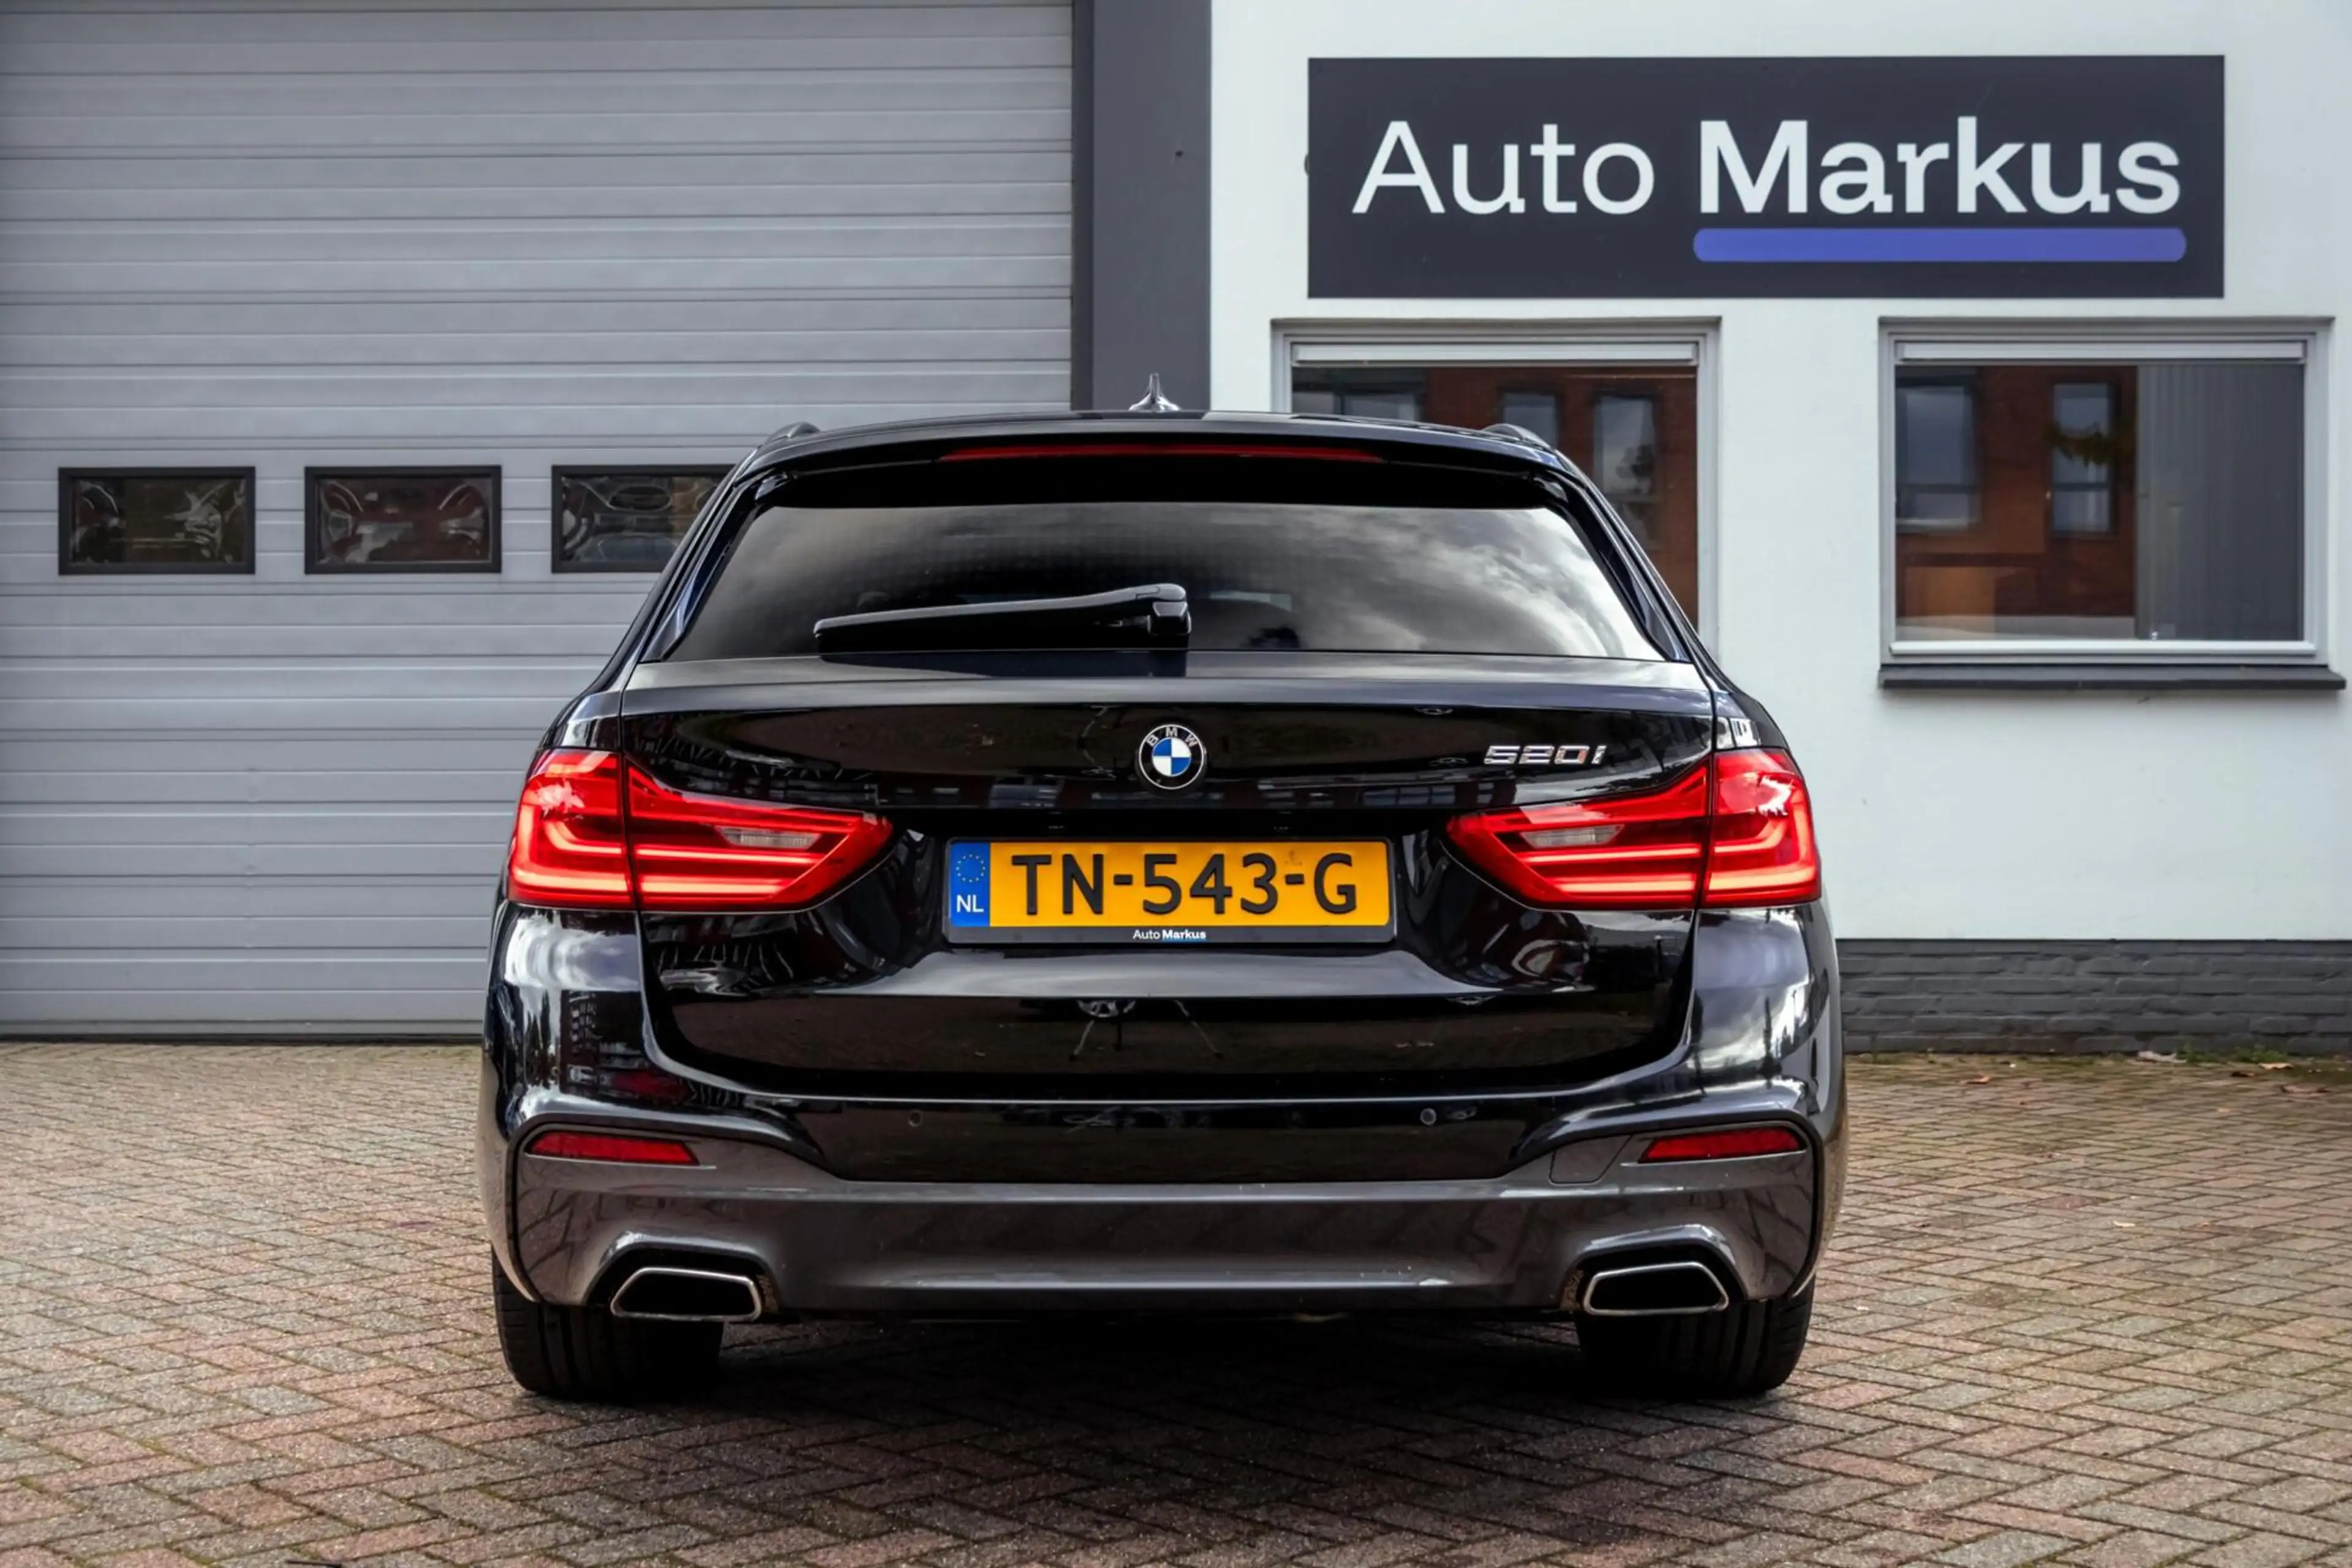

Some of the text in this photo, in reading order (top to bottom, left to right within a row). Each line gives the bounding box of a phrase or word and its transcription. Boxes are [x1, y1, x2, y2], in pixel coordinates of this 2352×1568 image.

[1352, 116, 2180, 215] Auto Markus
[1146, 727, 1198, 747] BMW
[1484, 745, 1607, 765] 520i
[1012, 853, 1357, 915] TN-543-G
[957, 894, 984, 913] NL
[1133, 929, 1207, 940] Auto Markus
